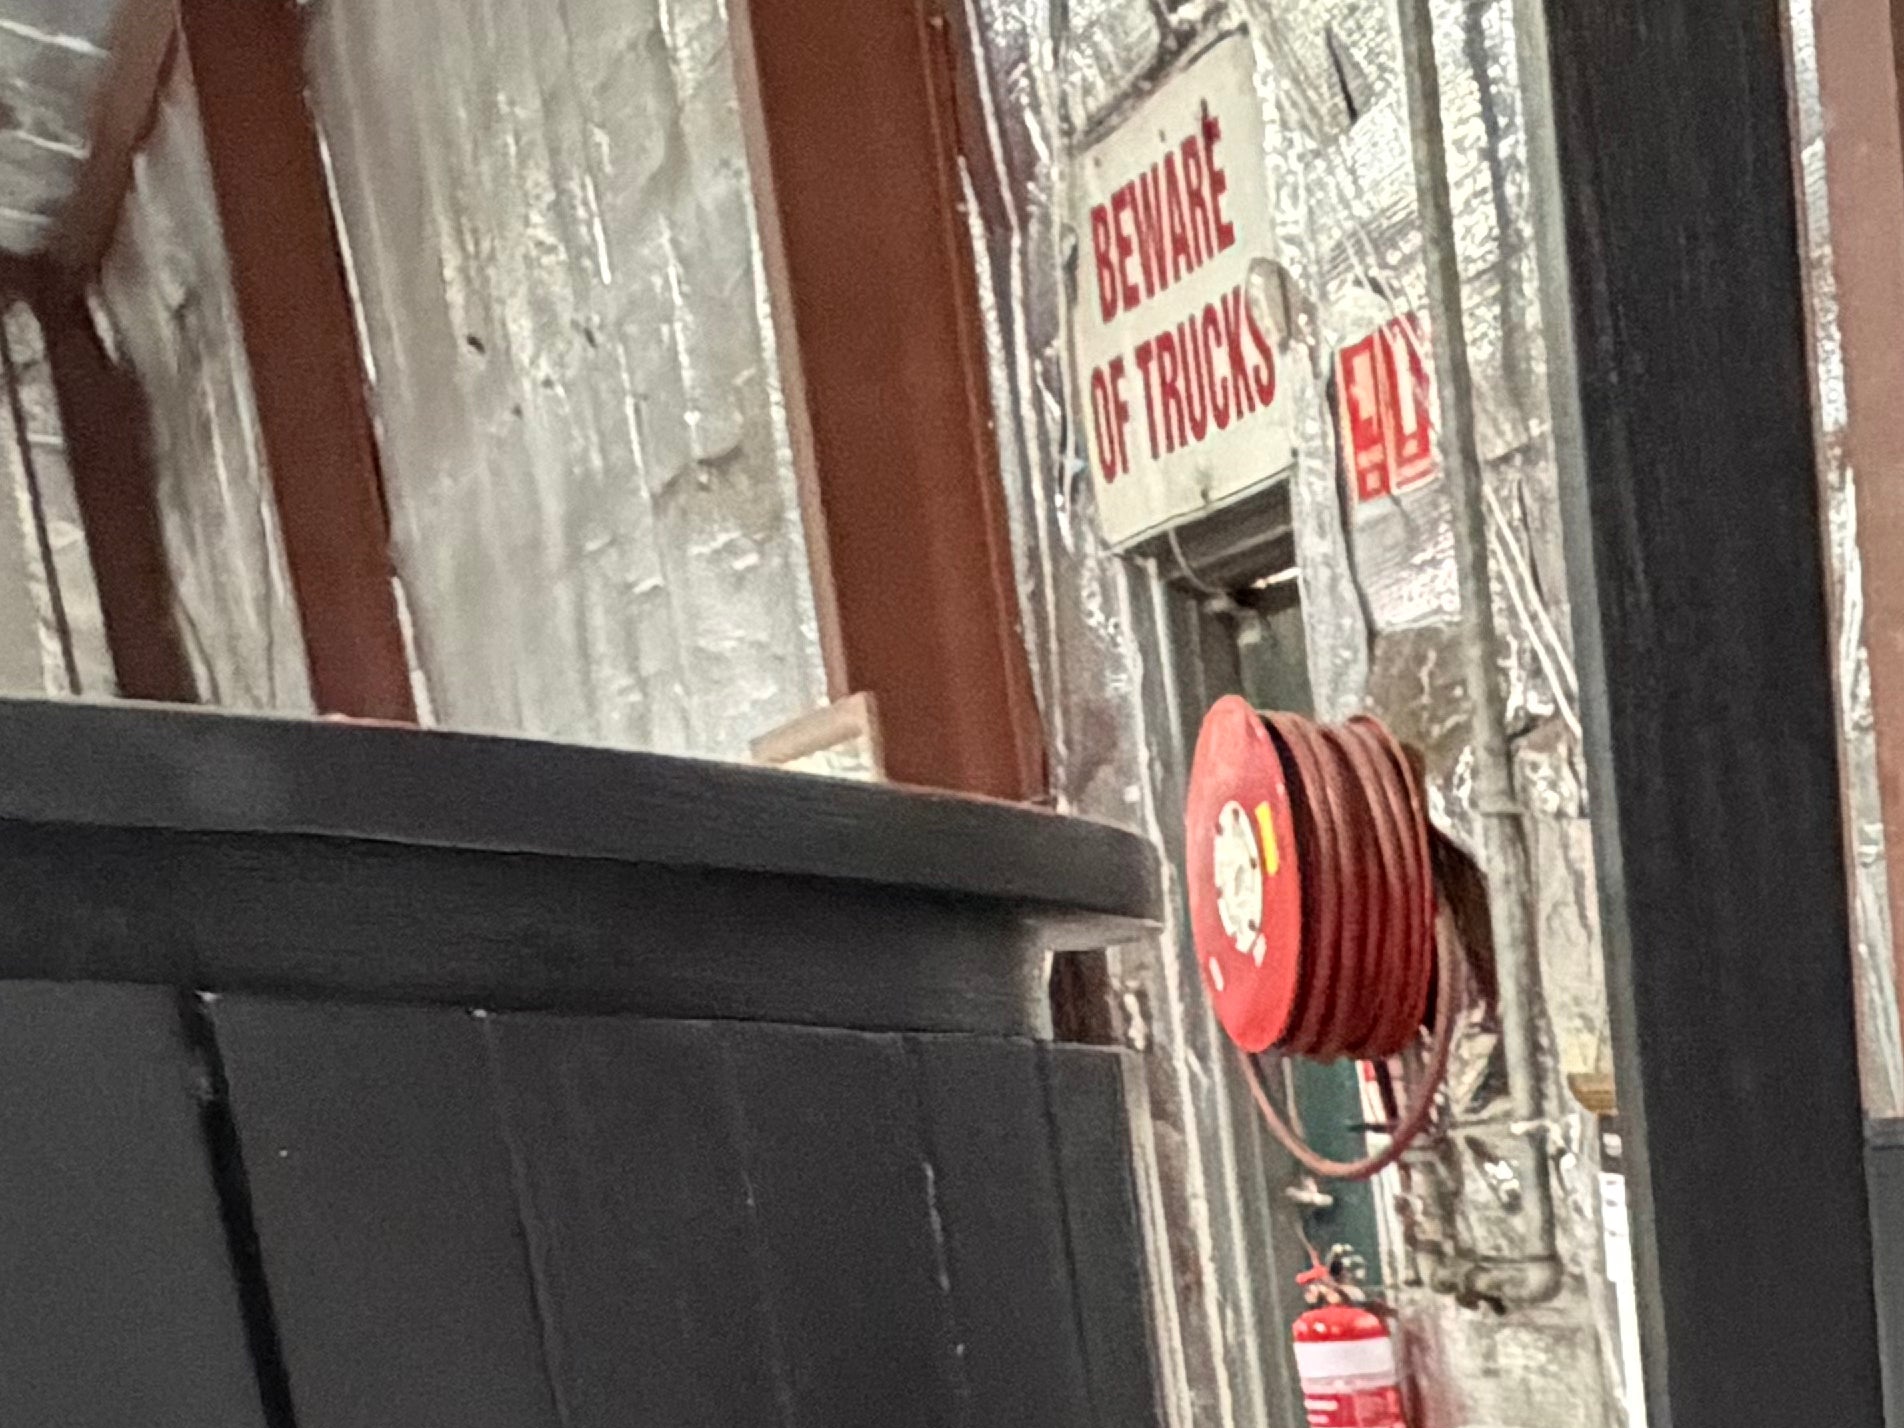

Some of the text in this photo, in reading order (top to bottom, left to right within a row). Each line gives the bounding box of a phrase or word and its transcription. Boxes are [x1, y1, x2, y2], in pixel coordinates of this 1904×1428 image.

[1090, 116, 1235, 324] BEWARE
[1090, 284, 1276, 484] OF TRUCKS
